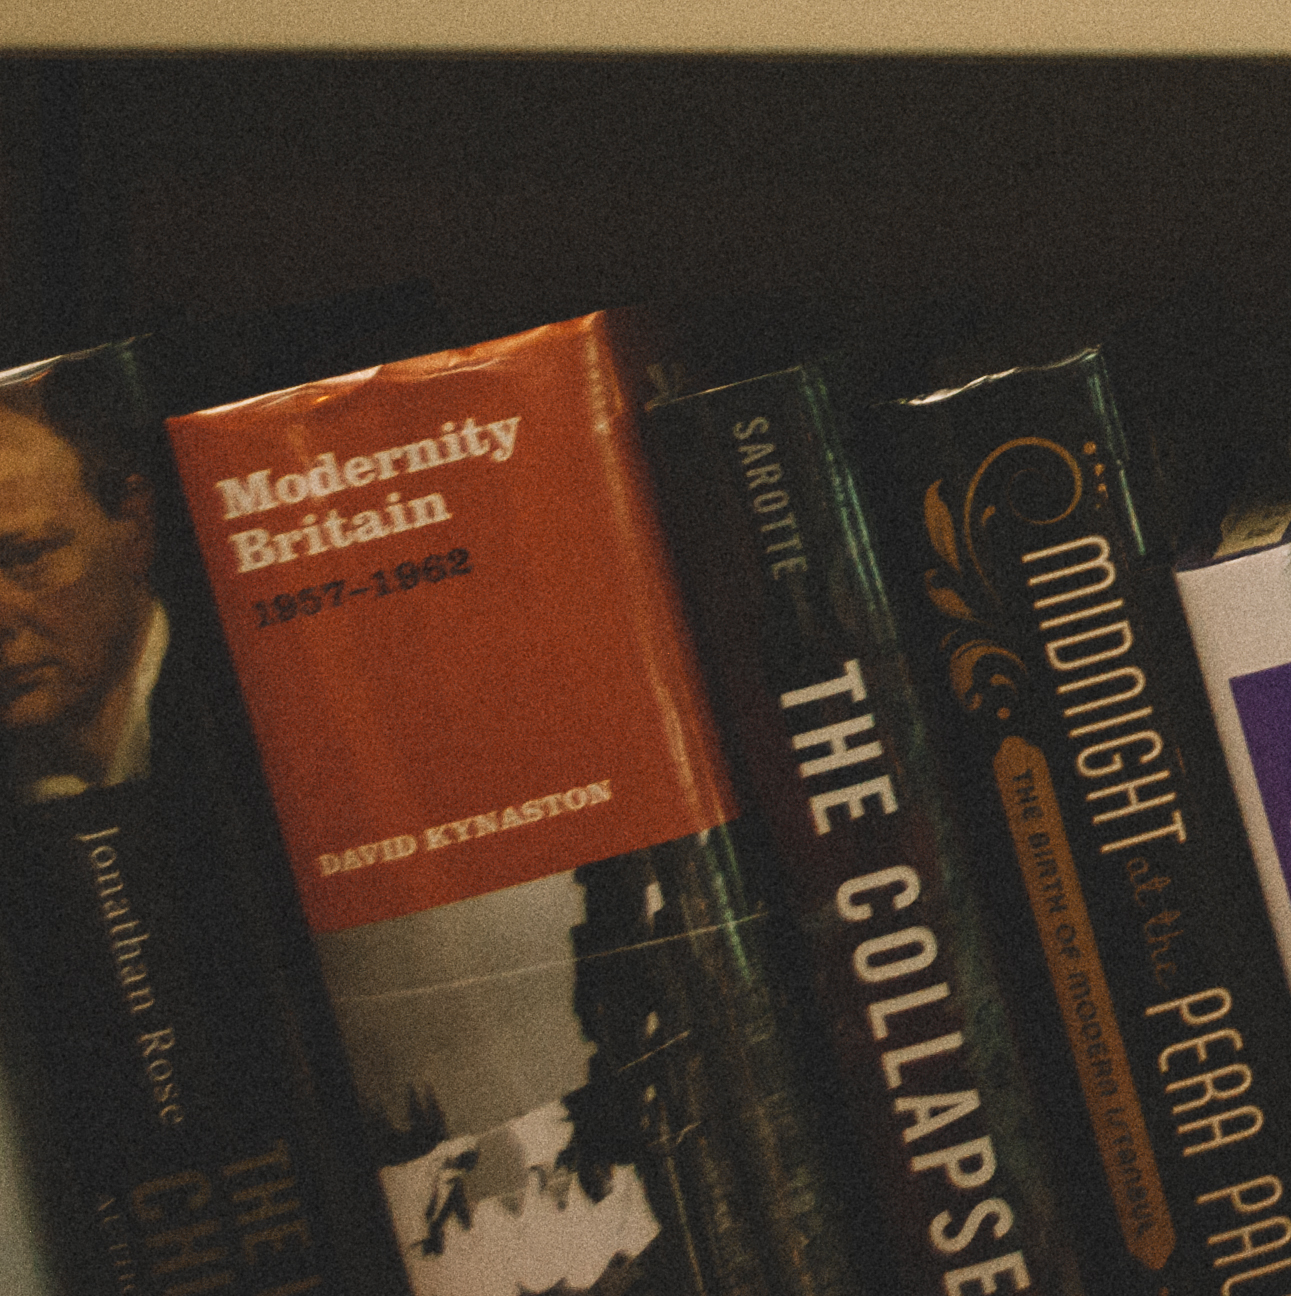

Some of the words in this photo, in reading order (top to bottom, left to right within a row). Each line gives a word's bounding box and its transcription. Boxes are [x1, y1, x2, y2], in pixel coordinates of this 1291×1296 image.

[216, 416, 522, 522] Modernity
[229, 490, 454, 575] Britain
[732, 414, 809, 581] SAROTTE
[317, 833, 418, 878] DAVID
[424, 779, 612, 853] KYNASTON
[780, 658, 900, 836] THE
[1022, 534, 1188, 855] MIDNIGHT
[1144, 987, 1265, 1158] PERA
[76, 826, 158, 1015] Jonathan
[140, 1025, 185, 1126] Rose
